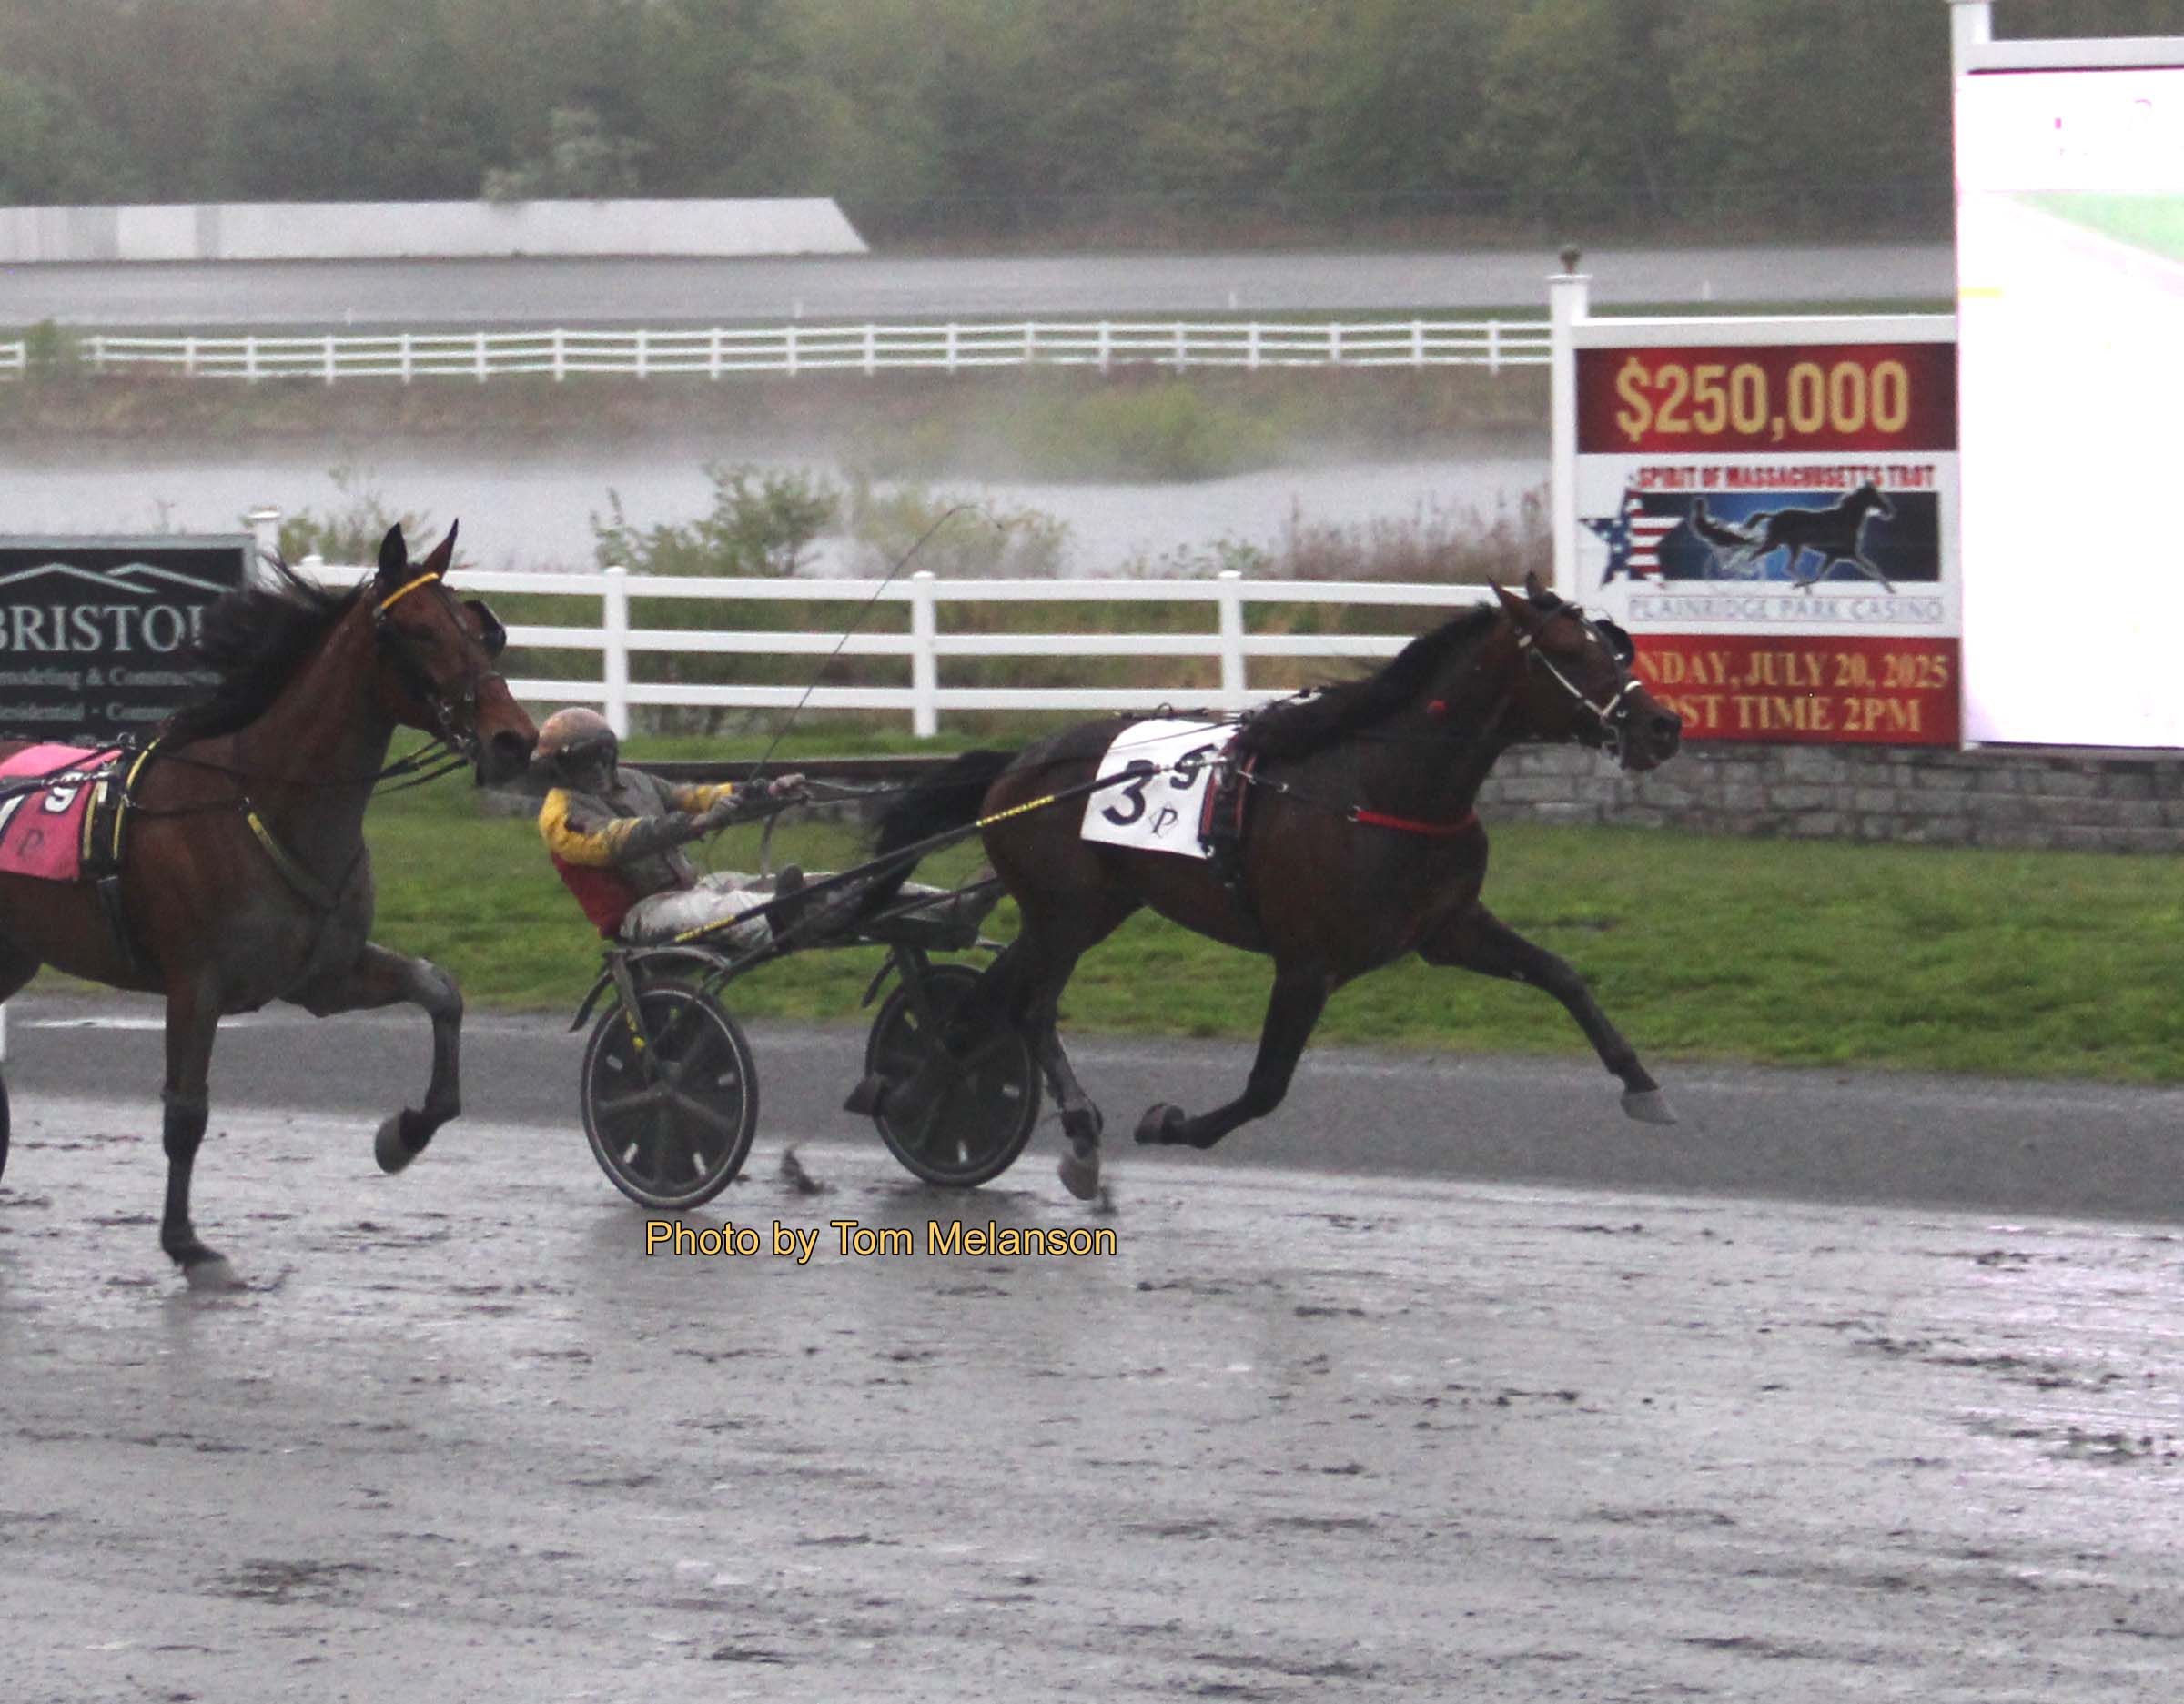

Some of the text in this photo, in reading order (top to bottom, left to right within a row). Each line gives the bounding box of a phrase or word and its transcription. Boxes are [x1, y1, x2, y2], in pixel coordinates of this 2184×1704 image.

[1615, 356, 1910, 442] $250,000
[1780, 598, 1839, 620] PARK
[1849, 598, 1946, 620] CASINO
[1746, 650, 1829, 688] JULY
[1883, 653, 1949, 690] 2025
[1731, 695, 1834, 731] TIME
[1842, 697, 1923, 733] 2PM
[1102, 760, 1154, 827] 3
